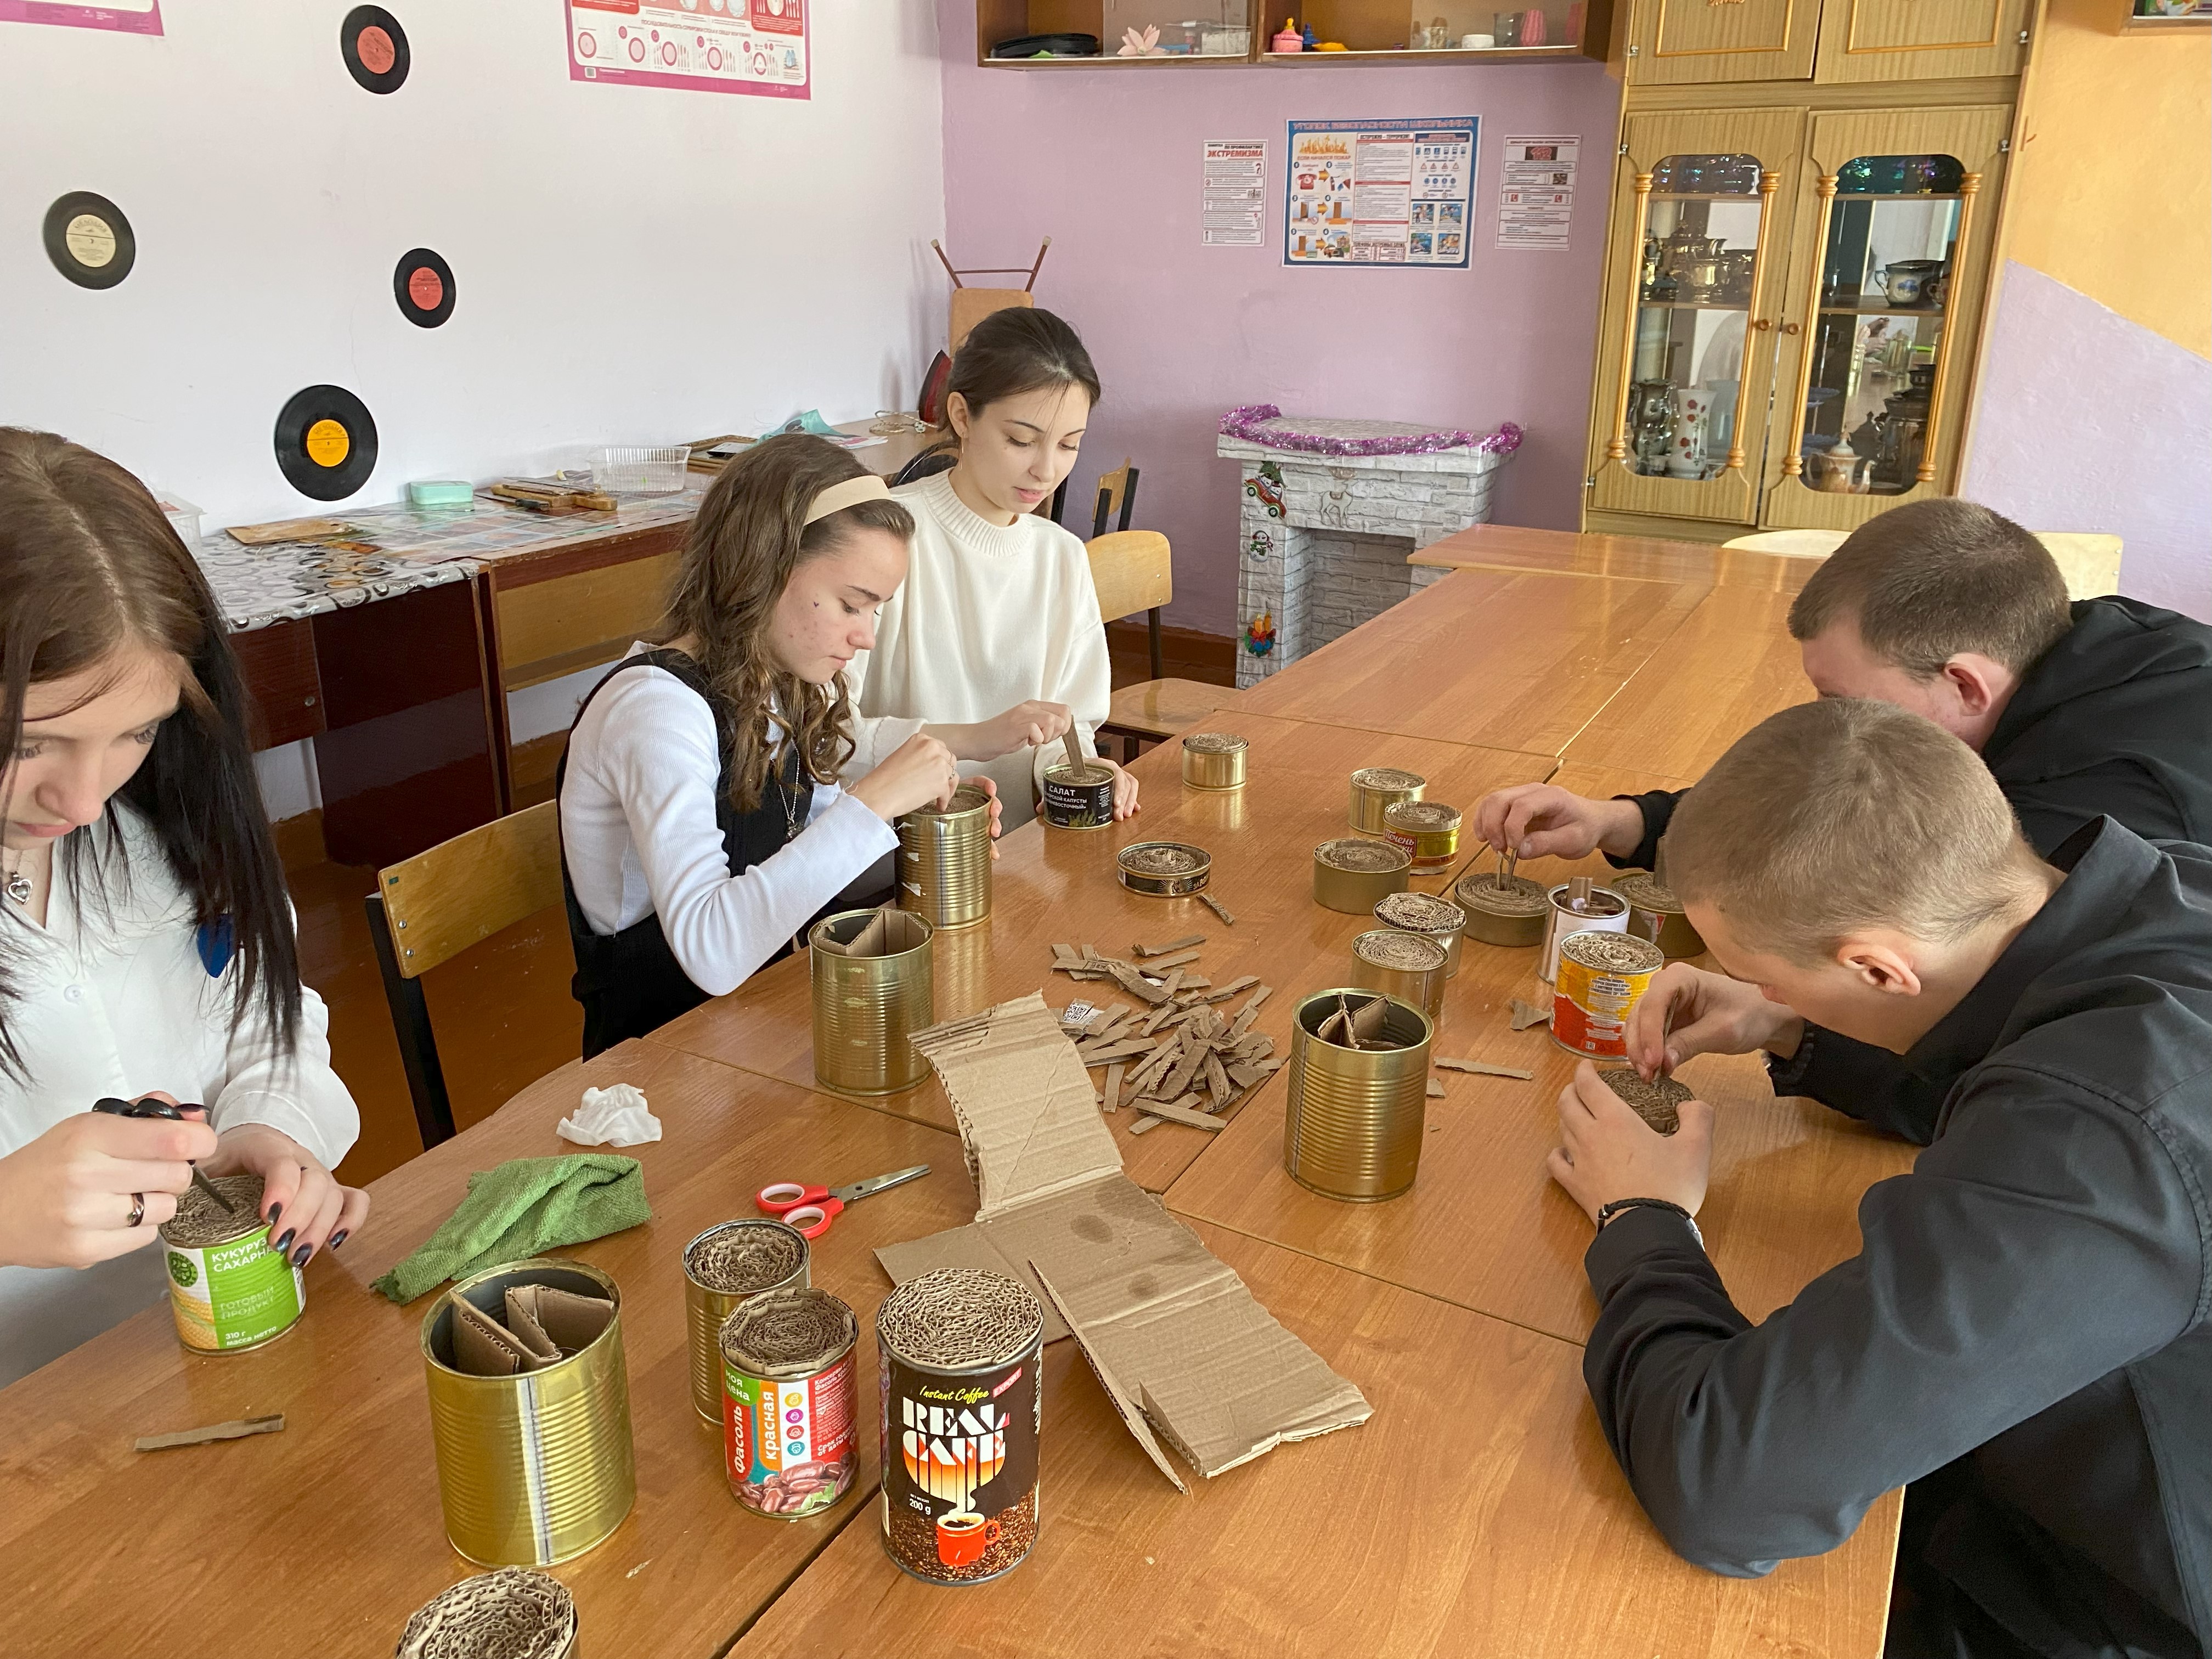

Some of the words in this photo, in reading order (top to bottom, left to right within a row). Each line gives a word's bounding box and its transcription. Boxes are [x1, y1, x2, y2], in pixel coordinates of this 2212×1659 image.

[1049, 785, 1076, 796] САЛАТ
[1385, 828, 1415, 846] Печень
[212, 1237, 267, 1262] КУКУРУЗ
[227, 1336, 252, 1346] масса
[253, 1326, 276, 1340] нетто
[726, 1380, 750, 1401] цена
[815, 1376, 837, 1391] Фасоль
[994, 1369, 1020, 1397] EXPORT
[919, 1385, 955, 1400] Instant
[955, 1387, 989, 1404] Coffee
[763, 1391, 780, 1460] красная
[902, 1396, 1008, 1436] REAL
[734, 1406, 746, 1474] Фасоль
[817, 1439, 835, 1452] Срок
[909, 1498, 923, 1511] 200
[925, 1506, 931, 1515] g
